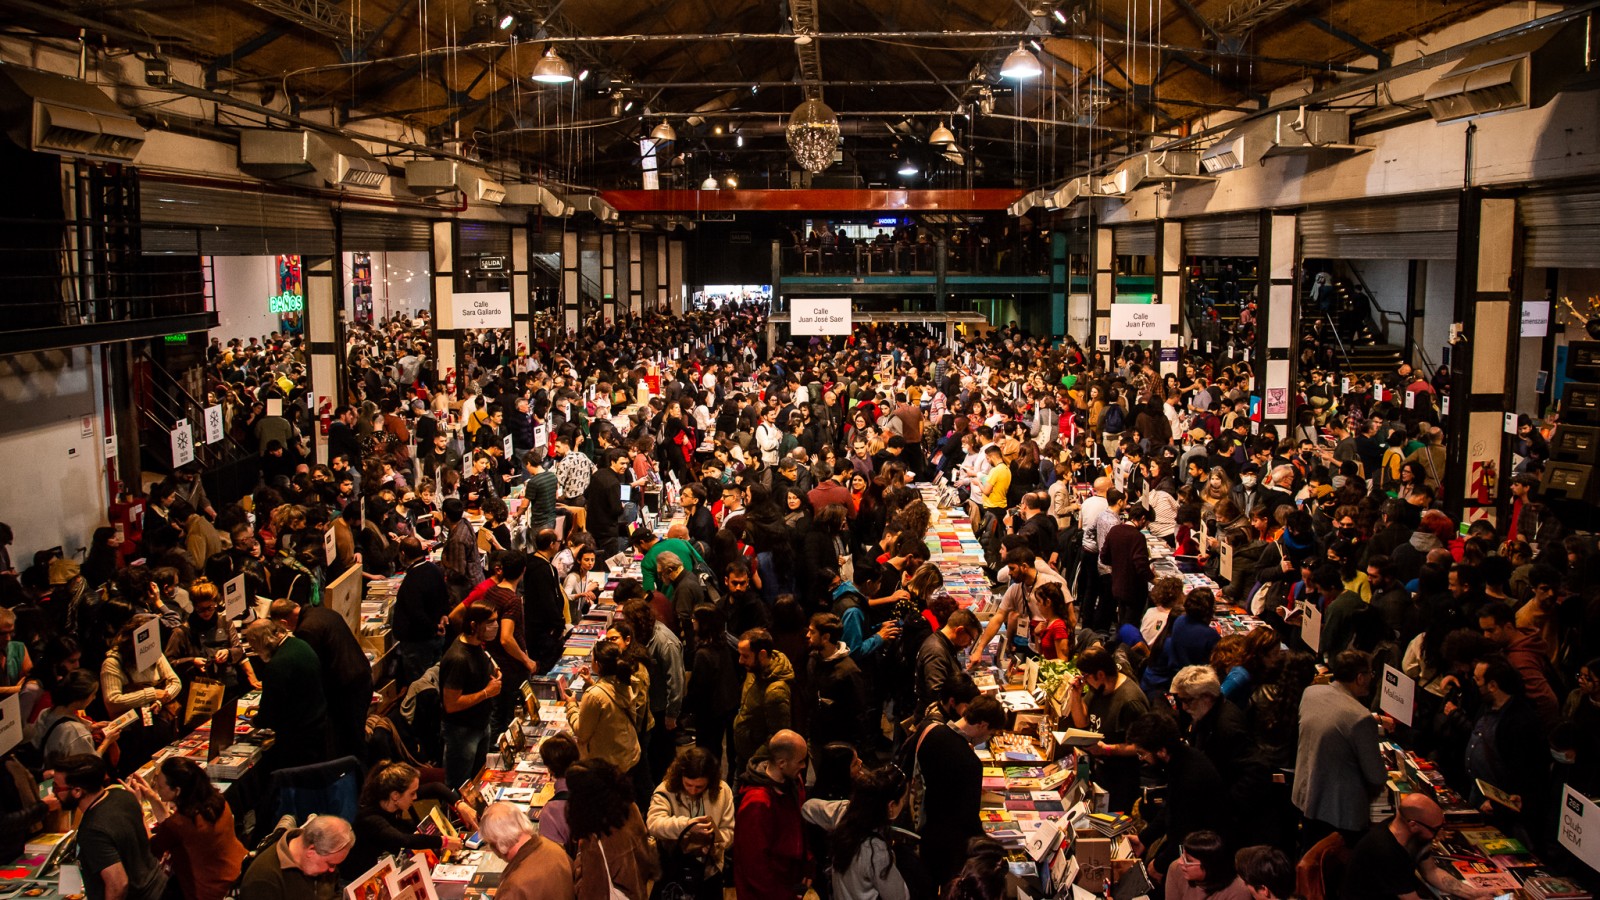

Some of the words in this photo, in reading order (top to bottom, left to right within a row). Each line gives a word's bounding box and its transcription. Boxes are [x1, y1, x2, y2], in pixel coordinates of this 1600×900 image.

[481, 258, 501, 267] SALIDA
[270, 291, 303, 313] BAÑOS
[477, 308, 502, 316] Gallardo
[813, 307, 829, 315] Calle
[814, 315, 829, 323] José
[1133, 312, 1149, 320] Calle
[1125, 320, 1141, 328] Juan
[139, 641, 156, 656] Albino
[1384, 686, 1404, 705] Malisia
[1564, 814, 1583, 835] Club
[1562, 826, 1582, 848] HEM
